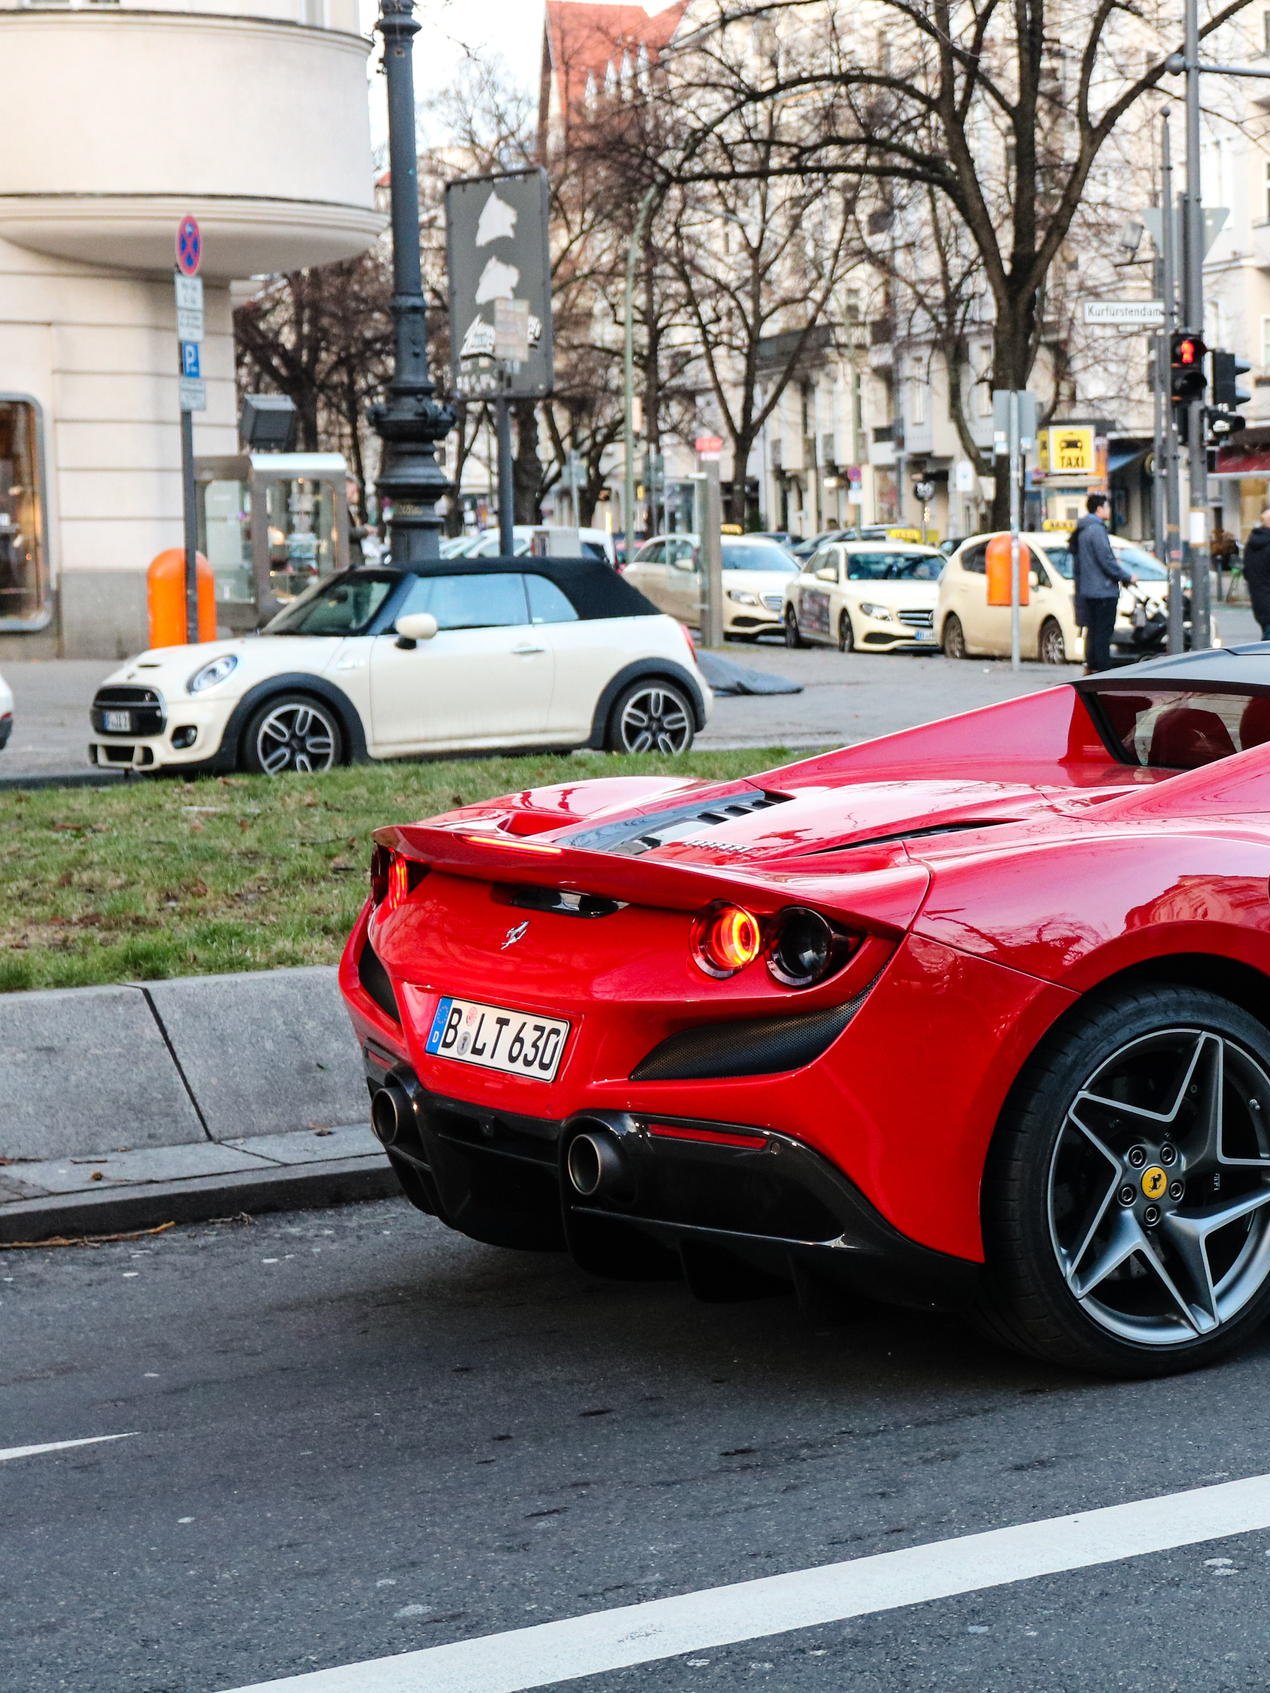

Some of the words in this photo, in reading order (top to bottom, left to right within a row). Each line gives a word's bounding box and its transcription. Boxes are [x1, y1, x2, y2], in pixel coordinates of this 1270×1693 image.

[1060, 456, 1084, 468] TAXI
[432, 1030, 440, 1043] D
[441, 1007, 463, 1049] B
[470, 1013, 511, 1059] LT
[507, 1021, 562, 1071] 630
